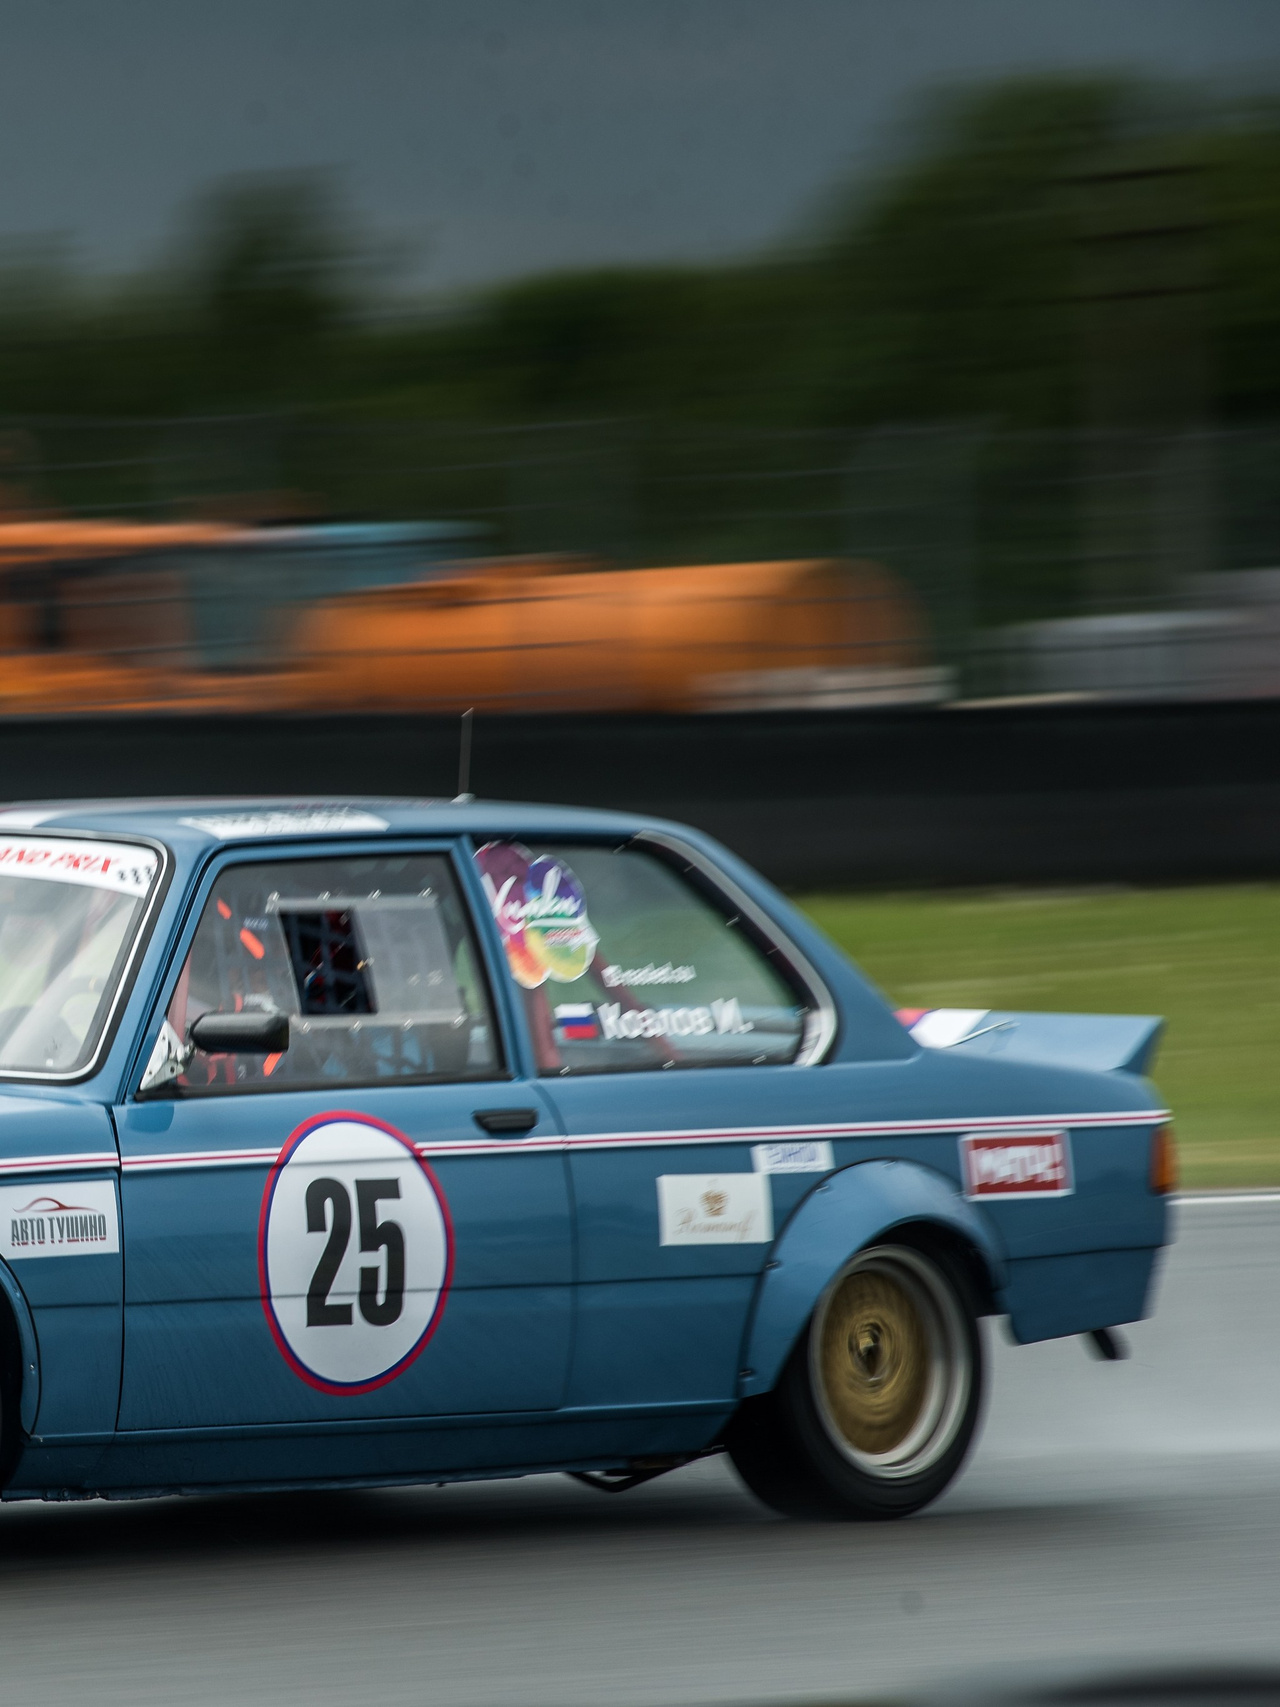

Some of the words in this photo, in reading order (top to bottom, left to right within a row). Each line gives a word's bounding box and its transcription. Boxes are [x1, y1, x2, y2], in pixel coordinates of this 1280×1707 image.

[50, 851, 119, 874] PRIX
[597, 1002, 715, 1040] Козлов
[11, 1217, 46, 1247] АВТО
[47, 1213, 107, 1243] ТУШИНО
[305, 1176, 407, 1328] 25
